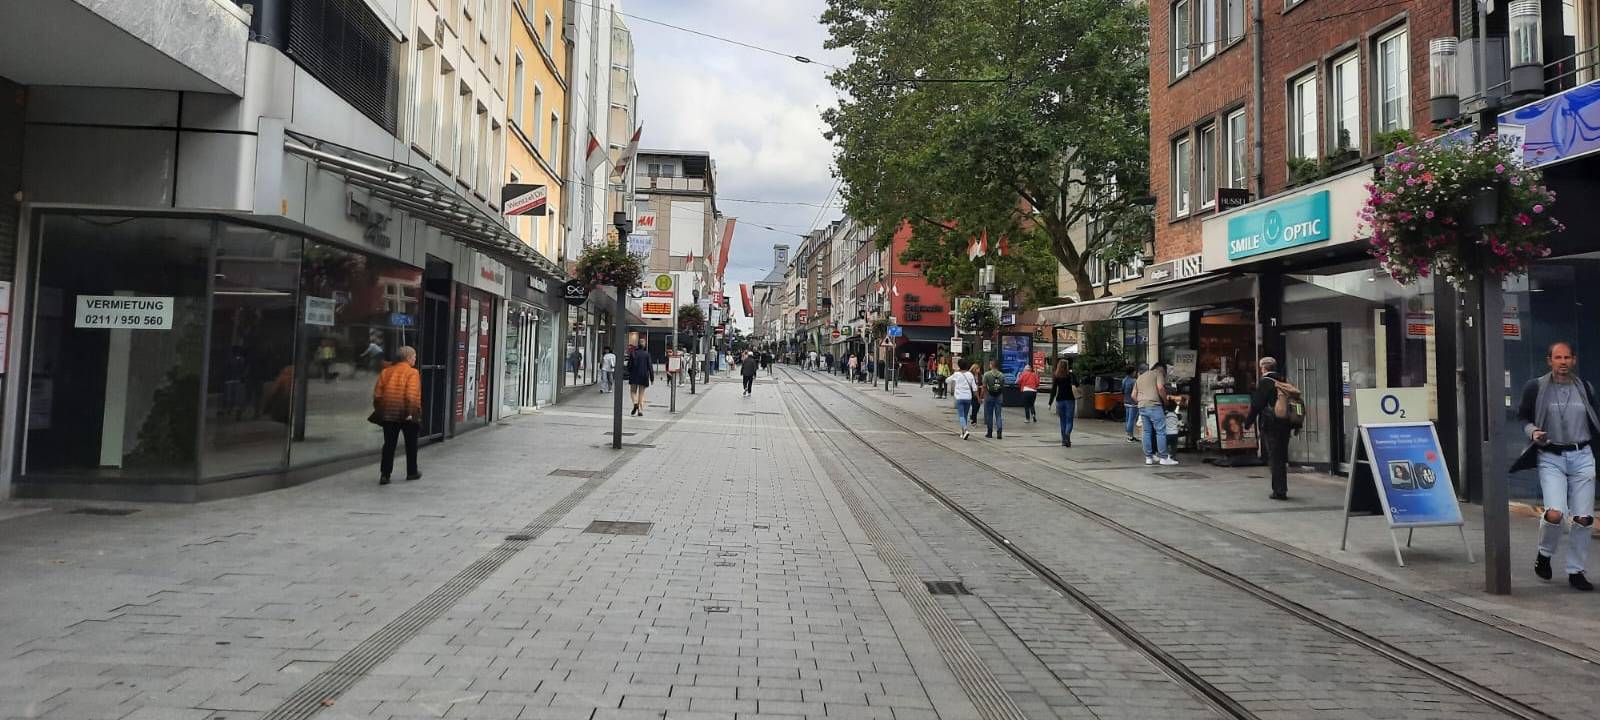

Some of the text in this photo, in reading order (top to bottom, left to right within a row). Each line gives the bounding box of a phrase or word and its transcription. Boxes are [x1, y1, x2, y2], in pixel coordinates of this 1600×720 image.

[1231, 219, 1321, 254] SMILE OPTIC
[86, 299, 164, 310] VERMIETUNG
[85, 315, 163, 325] 0211 / 950 560
[1381, 395, 1406, 418] O2
